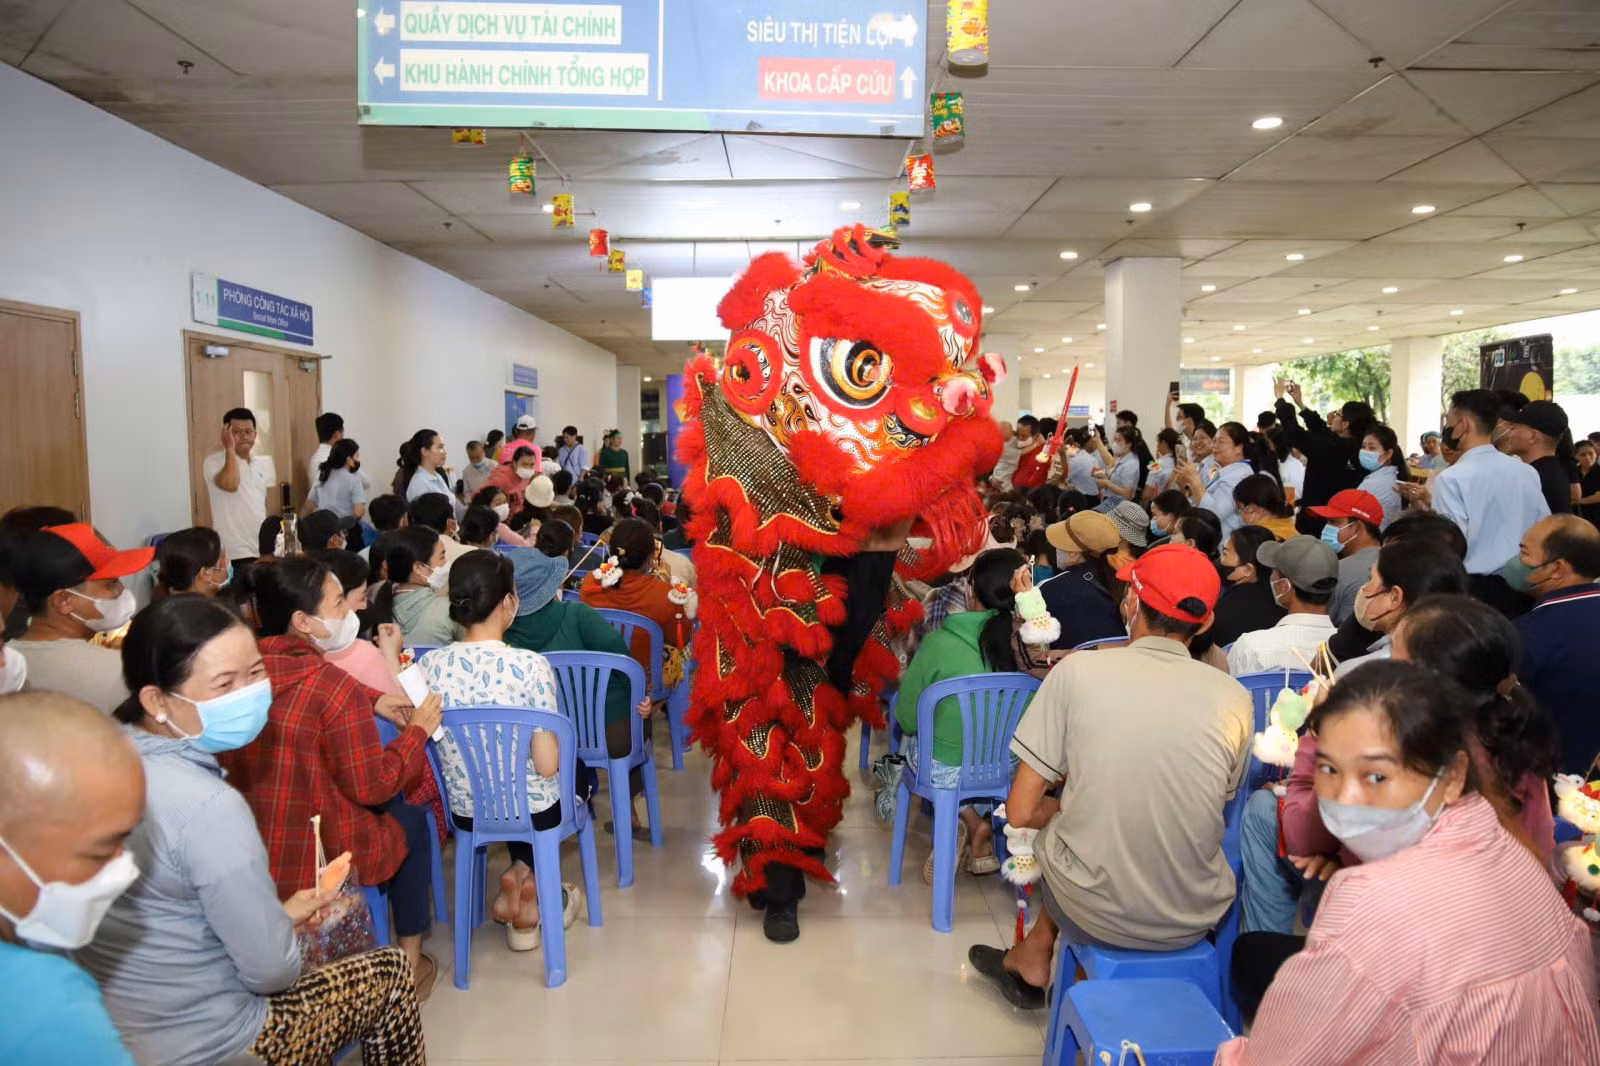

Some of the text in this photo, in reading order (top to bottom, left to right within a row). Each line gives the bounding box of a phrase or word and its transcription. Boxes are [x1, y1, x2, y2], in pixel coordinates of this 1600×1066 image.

[458, 14, 498, 40] DỊCH
[504, 15, 527, 41] VỤ
[531, 9, 558, 37] TÀI
[562, 9, 616, 38] CHÍNH
[747, 15, 786, 43] SIÊU
[791, 22, 818, 48] THỊ
[823, 18, 861, 49] TIỆN
[405, 55, 646, 93] KHU HÀNH CHÍNH TỔNG HỢP
[764, 64, 892, 97] KHOA CẤP CỨU
[223, 287, 252, 307] PHÒNG
[253, 295, 275, 313] CÔNG
[276, 302, 290, 316] TÁC
